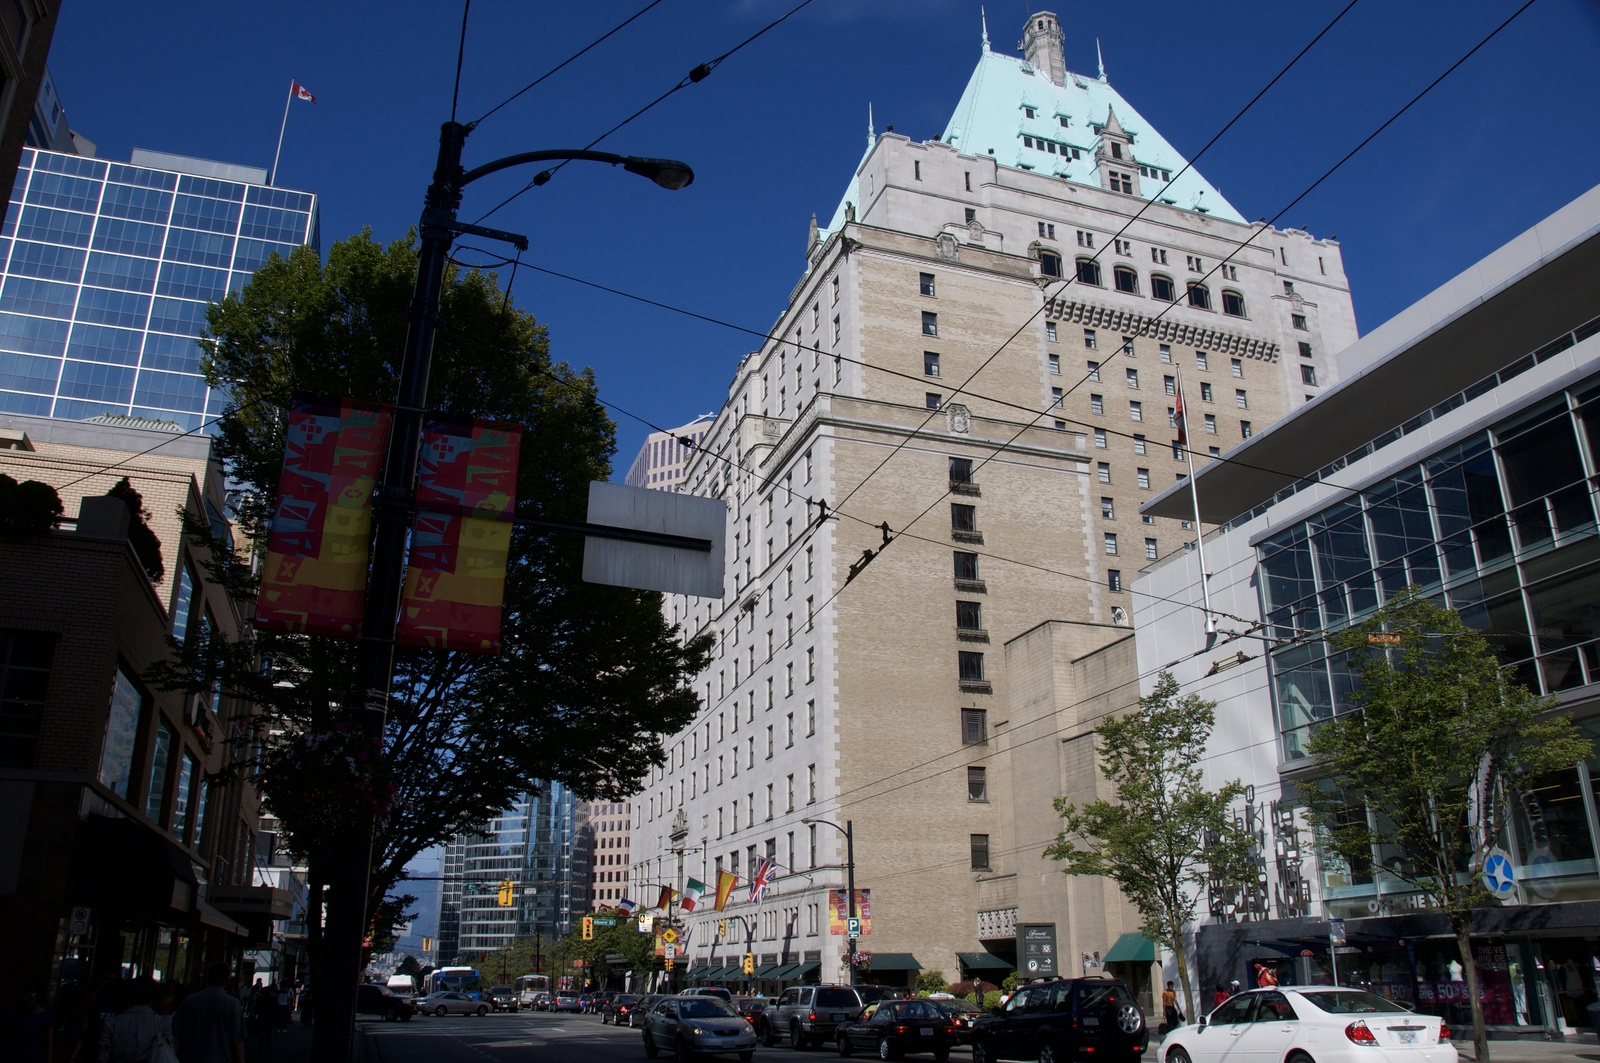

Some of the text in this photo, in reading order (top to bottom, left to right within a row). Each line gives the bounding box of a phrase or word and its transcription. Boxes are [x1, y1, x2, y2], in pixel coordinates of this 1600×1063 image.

[1367, 898, 1394, 913] OFF
[1401, 894, 1426, 910] THE
[849, 920, 857, 930] P
[1418, 988, 1434, 999] ale
[1461, 988, 1484, 999] se
